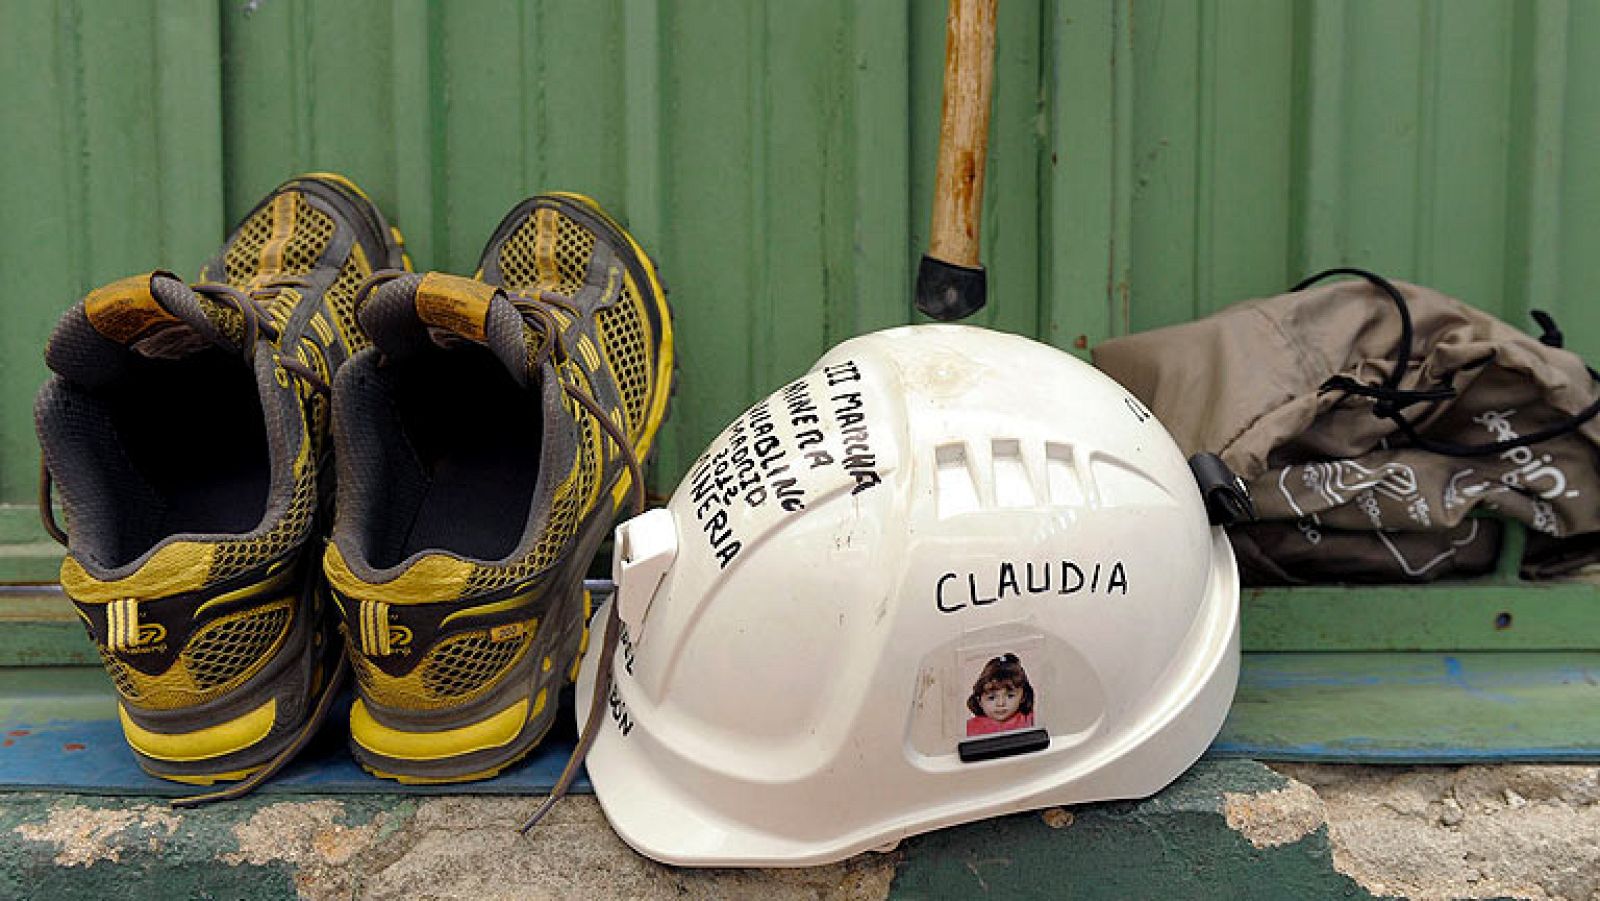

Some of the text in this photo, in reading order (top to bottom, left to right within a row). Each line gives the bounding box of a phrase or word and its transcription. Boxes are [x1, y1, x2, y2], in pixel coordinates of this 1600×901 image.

[783, 380, 835, 470] MINERA
[824, 360, 882, 496] III MARCHA
[936, 561, 1128, 613] CLAUDIA
